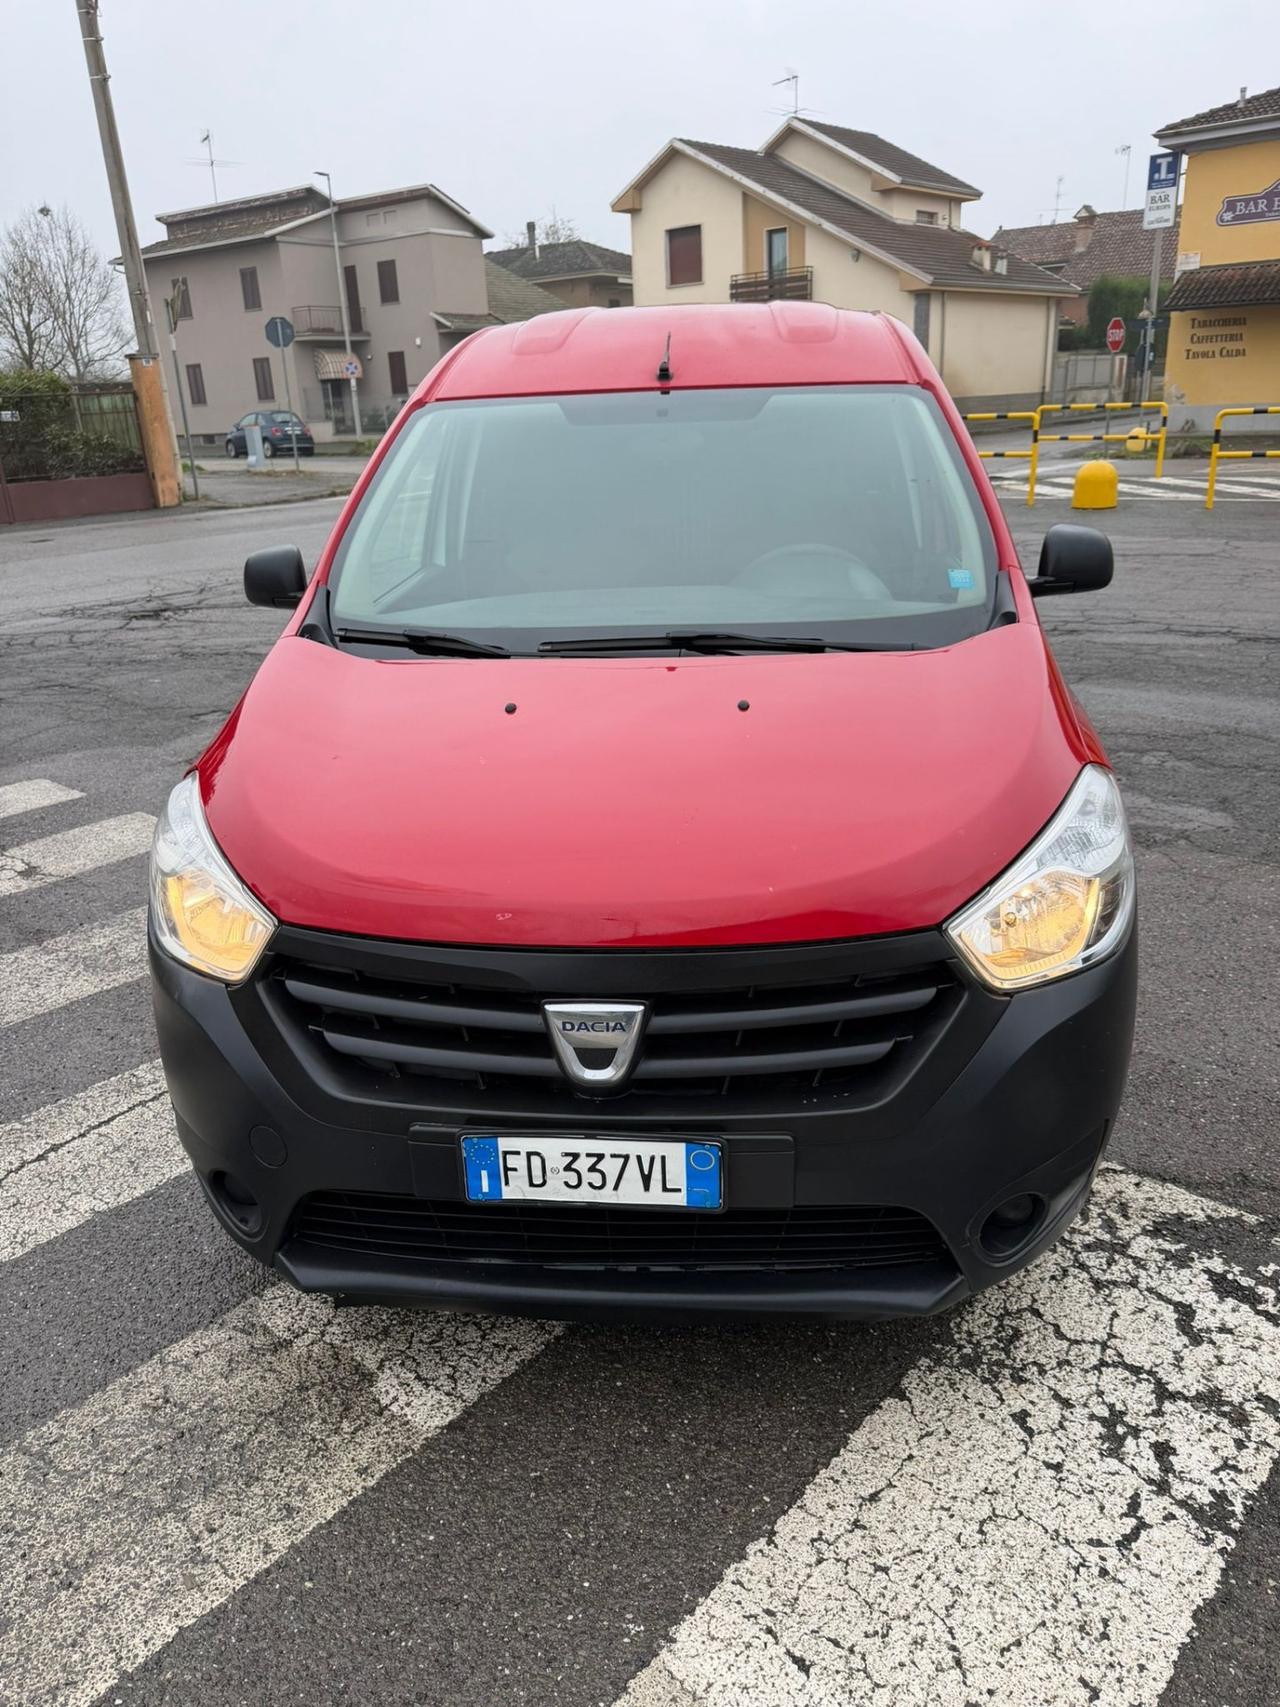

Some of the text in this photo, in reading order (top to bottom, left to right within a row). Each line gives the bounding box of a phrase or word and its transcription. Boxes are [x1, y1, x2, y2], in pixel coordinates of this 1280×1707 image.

[1150, 194, 1170, 204] BAR
[1235, 199, 1268, 215] BAR
[1107, 328, 1124, 342] STOP
[561, 1021, 626, 1033] DACIA
